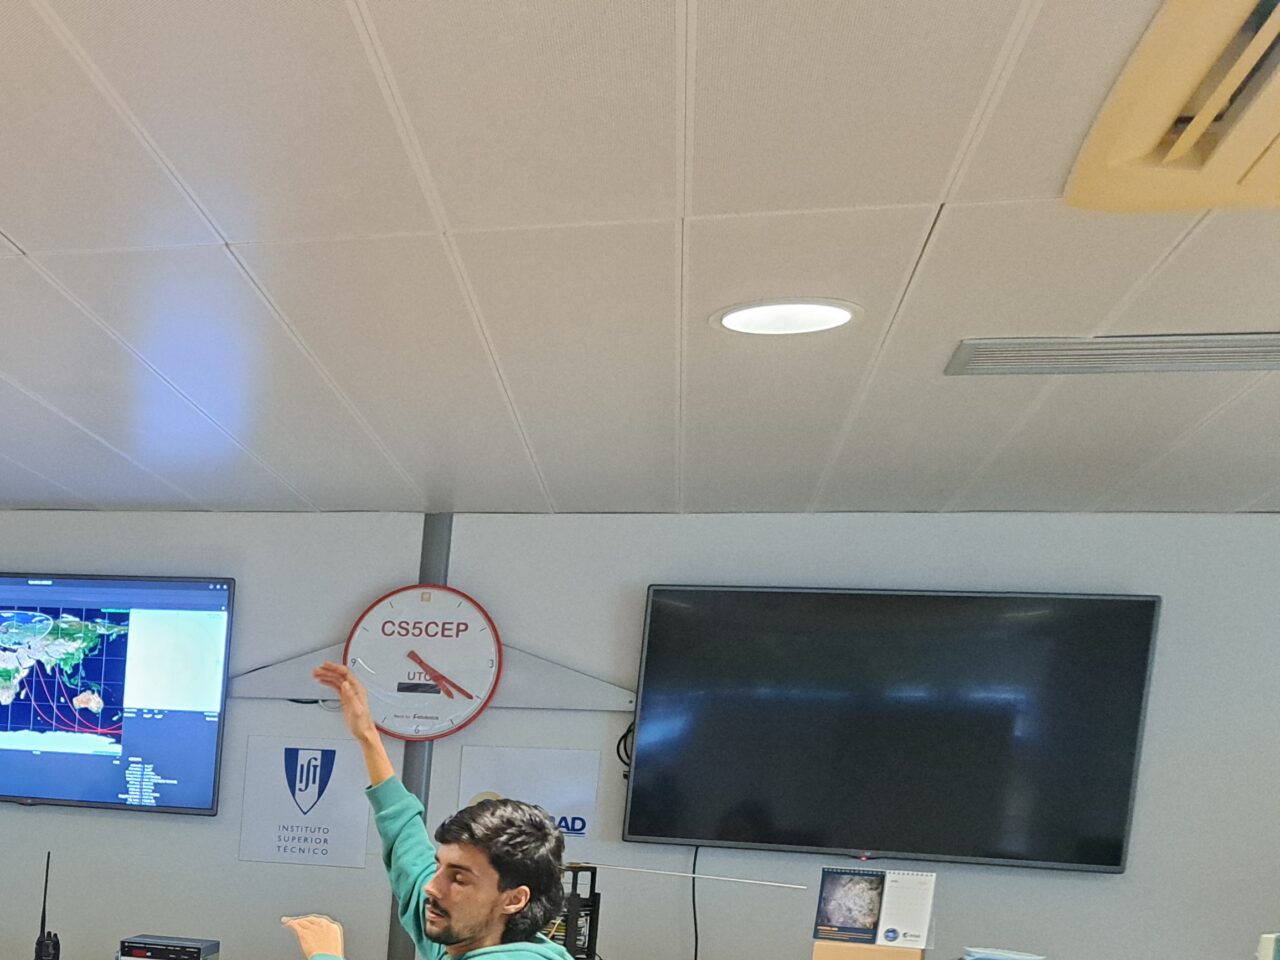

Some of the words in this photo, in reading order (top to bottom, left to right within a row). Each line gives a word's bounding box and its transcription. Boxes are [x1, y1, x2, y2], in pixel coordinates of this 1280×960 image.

[381, 620, 470, 638] CS5CEP
[414, 724, 420, 734] 6
[549, 816, 587, 832] AD
[278, 825, 330, 835] INSTITUTO
[277, 835, 329, 845] SUPERIOR
